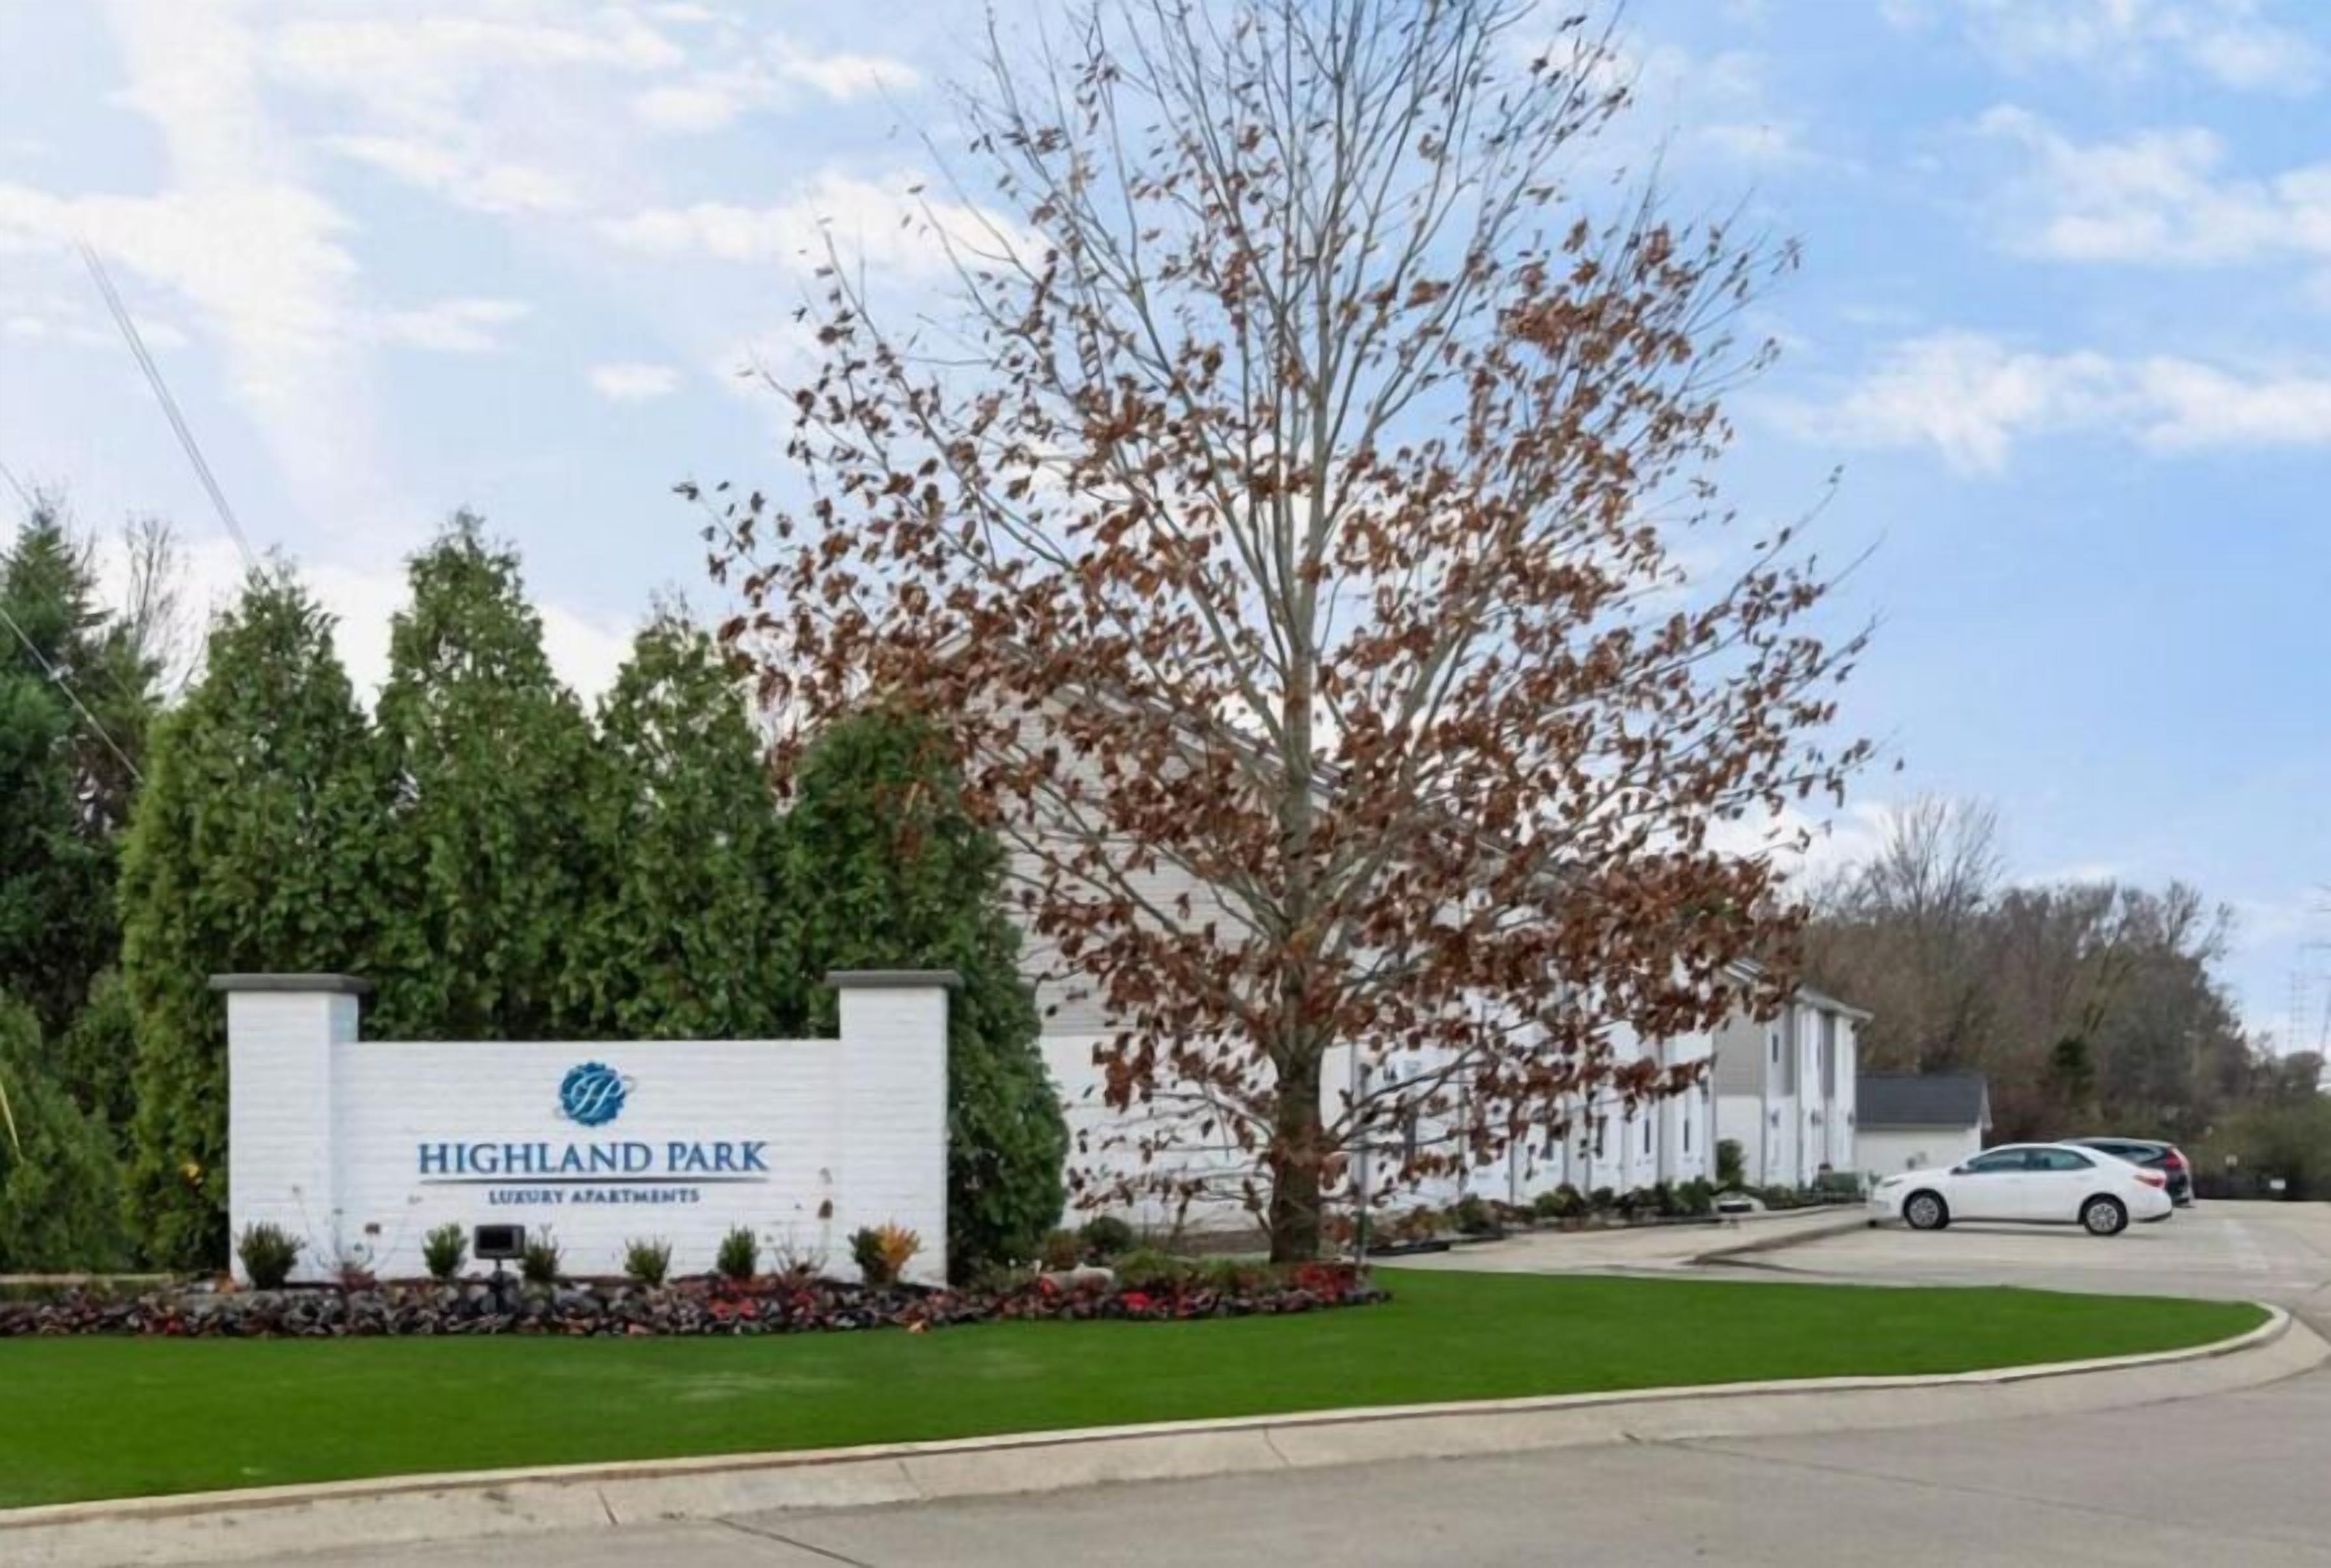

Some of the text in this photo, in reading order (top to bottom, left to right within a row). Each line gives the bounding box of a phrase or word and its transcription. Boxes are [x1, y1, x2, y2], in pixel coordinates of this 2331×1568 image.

[418, 1141, 770, 1174] HIGHLAND PARK
[488, 1188, 701, 1205] LUXURY APARTMENTS
